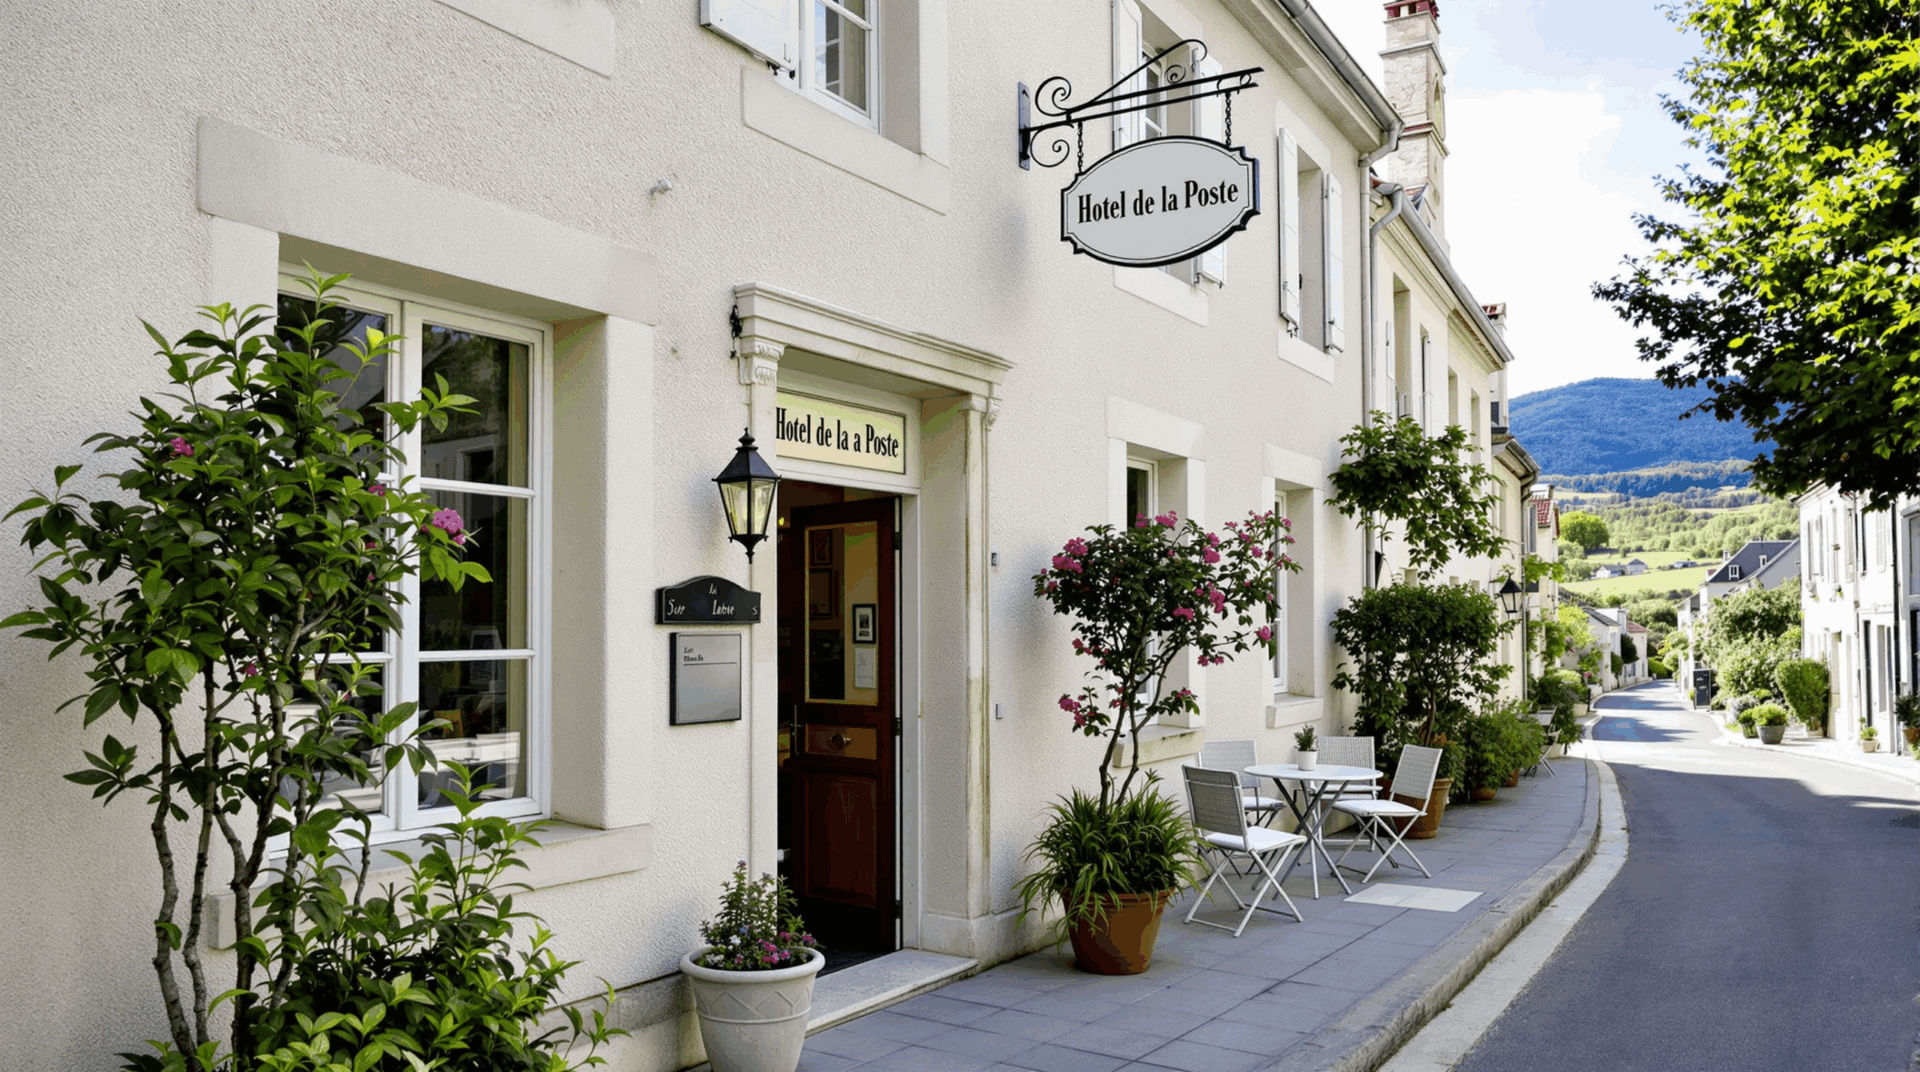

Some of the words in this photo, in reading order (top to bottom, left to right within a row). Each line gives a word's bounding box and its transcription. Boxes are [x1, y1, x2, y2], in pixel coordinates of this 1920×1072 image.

[1078, 191, 1126, 223] Hotel
[1133, 189, 1155, 216] de
[1161, 186, 1178, 212] la
[1184, 180, 1239, 208] Poste
[776, 406, 811, 444] Hotel
[816, 416, 832, 447] de
[837, 419, 849, 451] la
[853, 432, 861, 453] a
[866, 423, 899, 458] Poste
